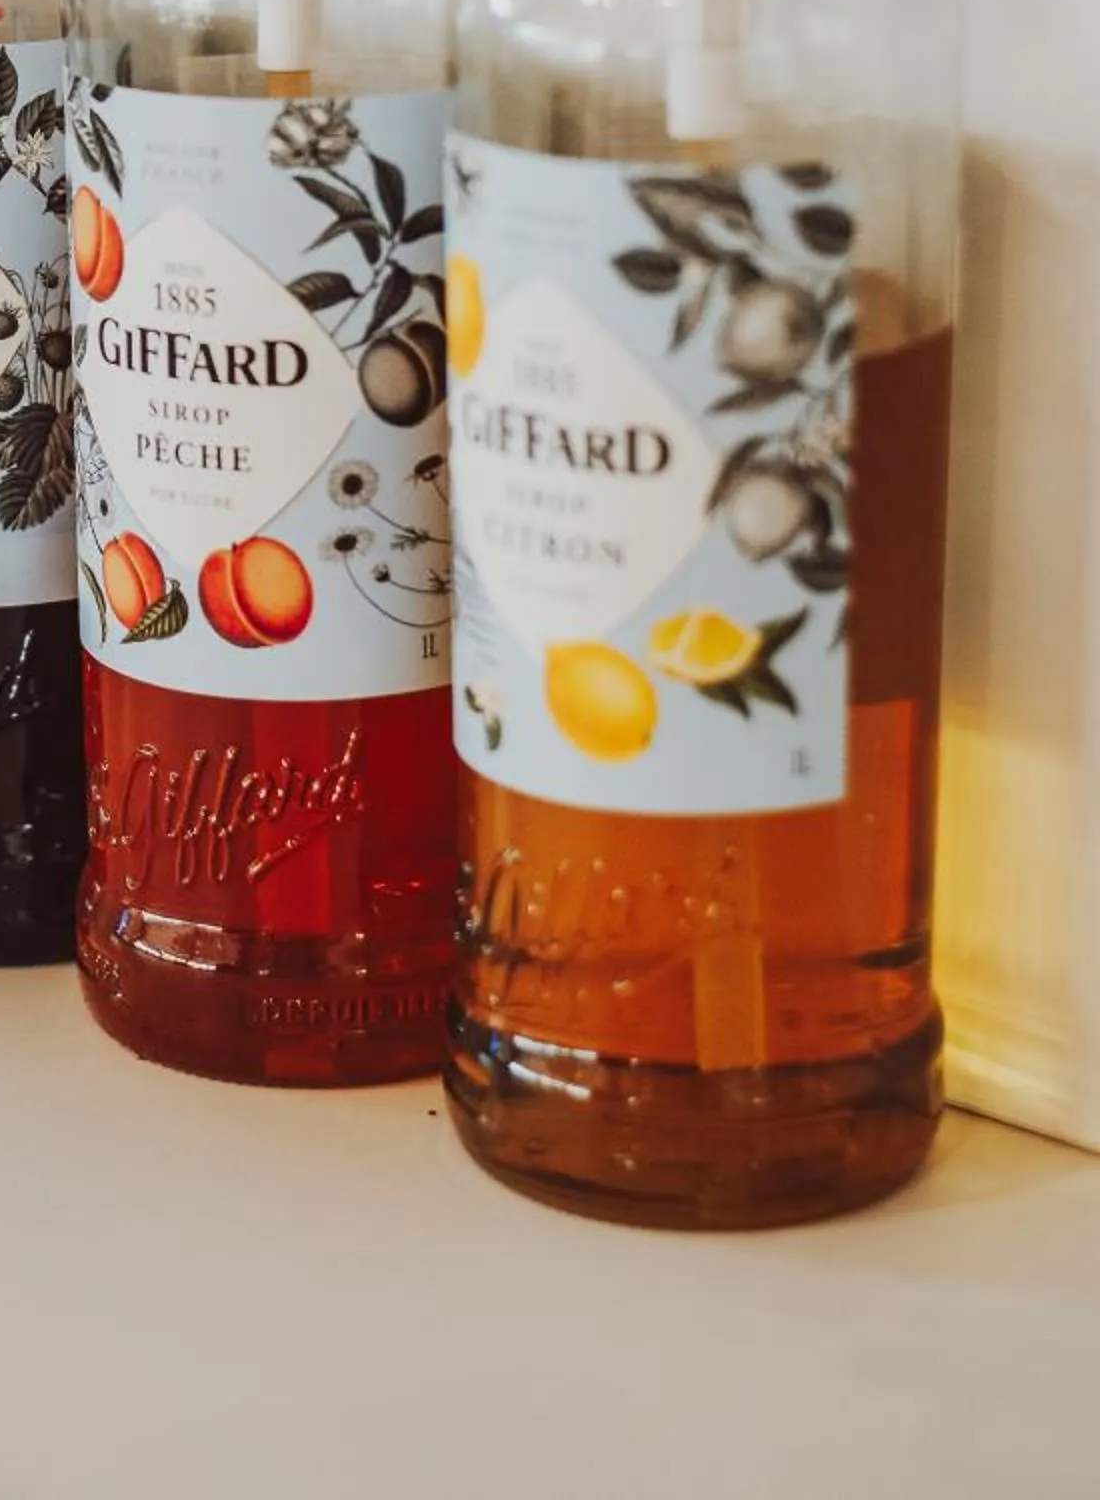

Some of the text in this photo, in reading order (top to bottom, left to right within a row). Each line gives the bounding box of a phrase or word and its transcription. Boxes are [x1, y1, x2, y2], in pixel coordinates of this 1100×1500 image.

[153, 280, 218, 317] 1885
[98, 316, 309, 387] GIFFARD
[148, 400, 230, 426] SIROP
[135, 431, 252, 473] PÊCHE
